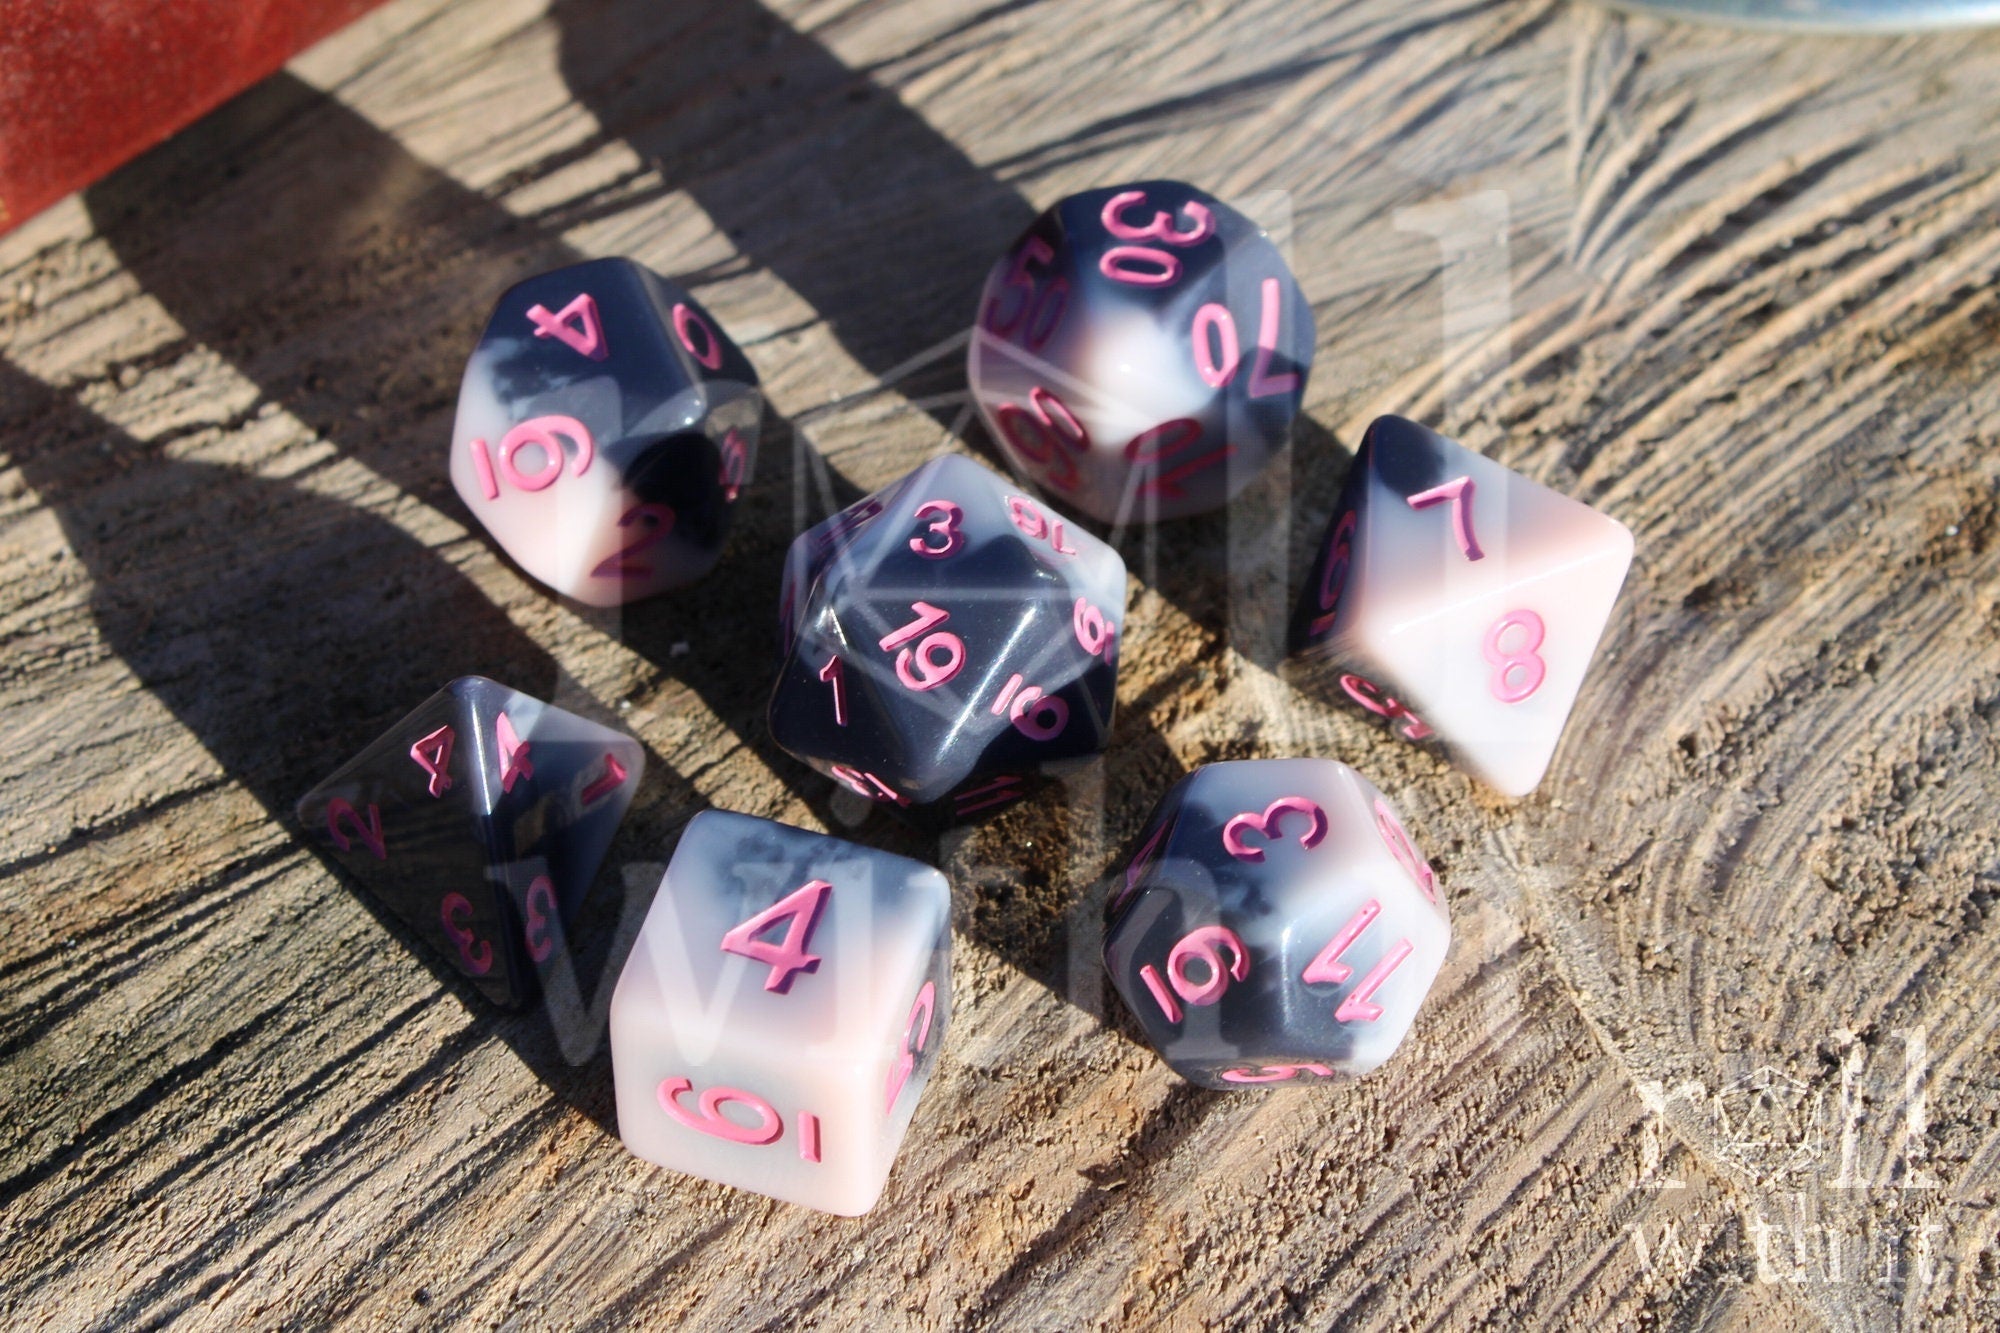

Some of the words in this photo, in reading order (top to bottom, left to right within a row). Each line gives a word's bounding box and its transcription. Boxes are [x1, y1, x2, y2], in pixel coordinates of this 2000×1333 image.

[1100, 190, 1216, 288] 30
[525, 291, 609, 362] 4
[672, 302, 723, 371] 0
[1191, 276, 1300, 397] 70
[589, 502, 677, 578] 2
[909, 500, 965, 560] 3
[1407, 475, 1484, 562] 7
[878, 600, 968, 692] 19
[1482, 608, 1546, 703] 8
[819, 654, 848, 727] 1
[410, 724, 456, 799] 4
[496, 711, 534, 794] 4
[581, 753, 628, 806] 1
[326, 797, 388, 861] 2
[1222, 796, 1329, 863] 3
[441, 892, 494, 976] 3
[526, 875, 556, 962] 3
[720, 879, 834, 996] 4
[1302, 898, 1415, 1024] 11
[1221, 1062, 1334, 1083] 5
